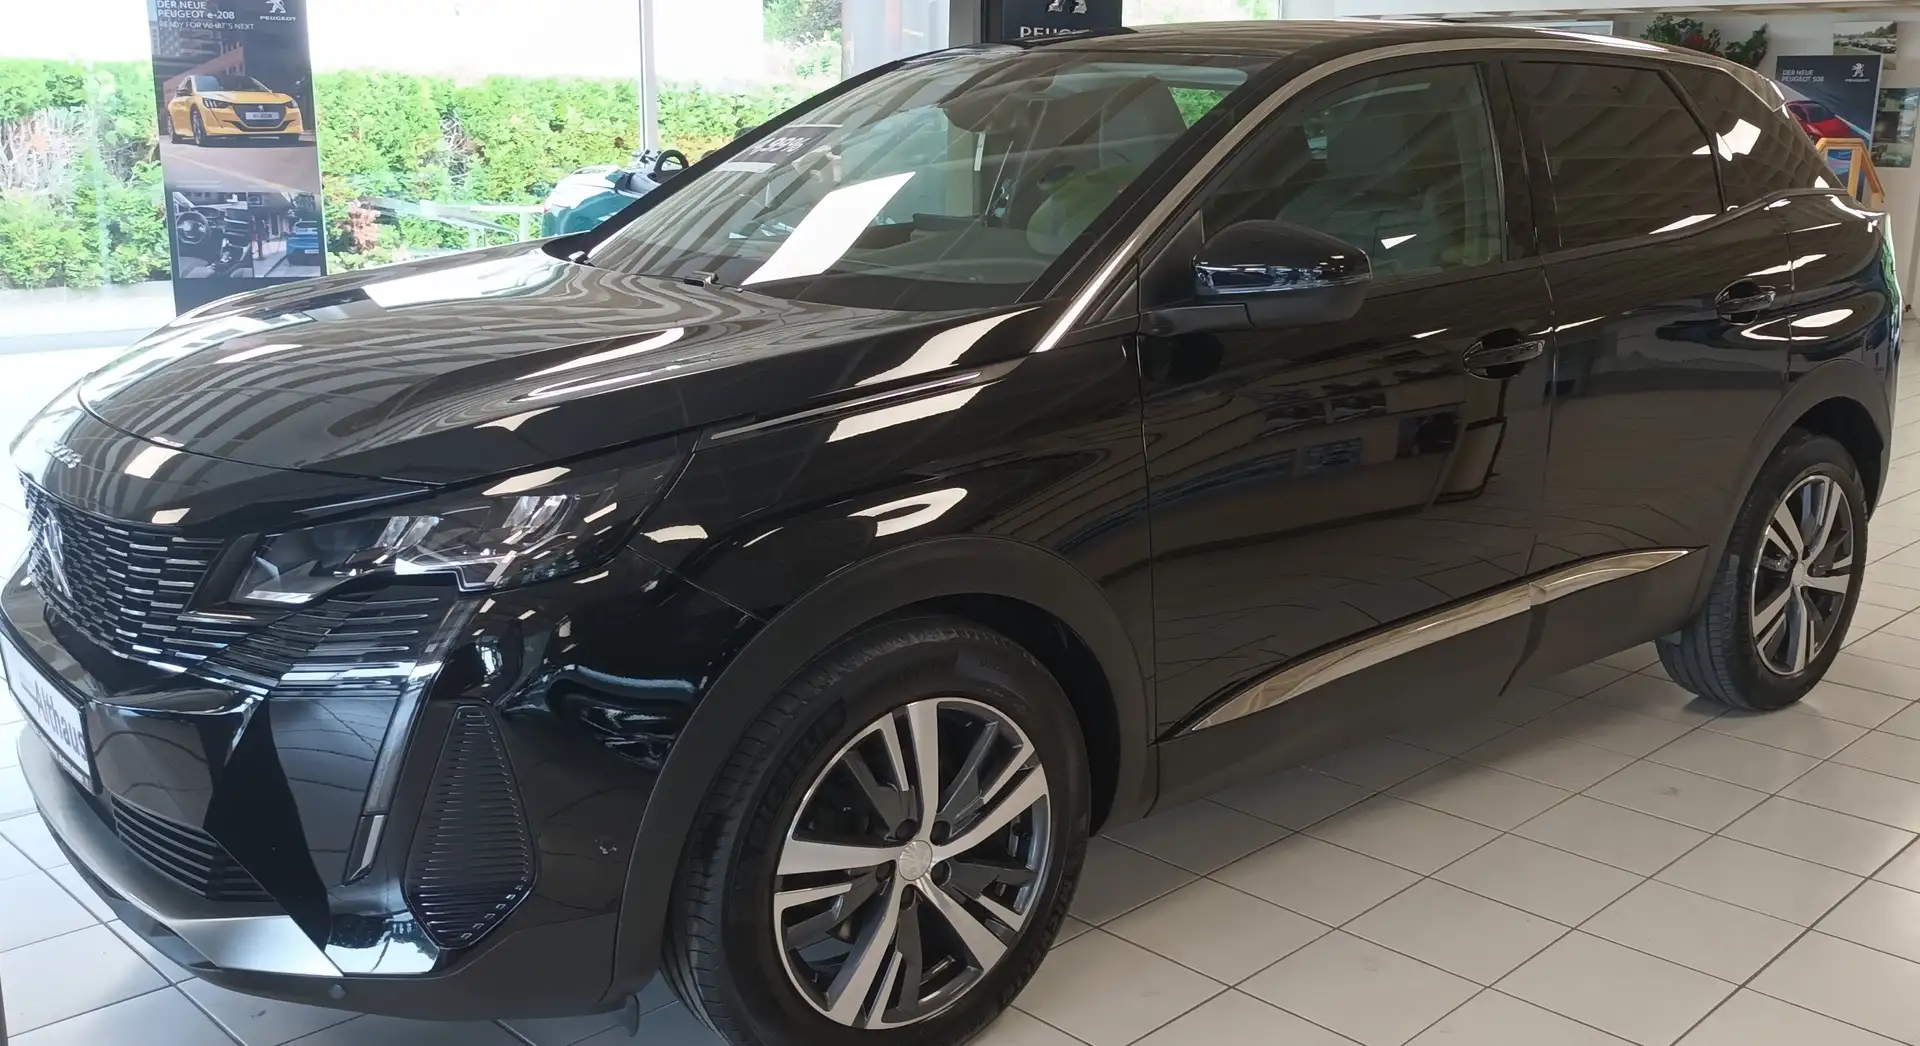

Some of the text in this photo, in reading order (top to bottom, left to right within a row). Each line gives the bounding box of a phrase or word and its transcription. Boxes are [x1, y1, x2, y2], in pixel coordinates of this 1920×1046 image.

[157, 0, 207, 9] DER NEUE
[158, 9, 235, 20] PEUGEOT e-208
[159, 20, 184, 29] READY
[185, 21, 202, 29] FOR
[202, 22, 233, 30] WHAT'S
